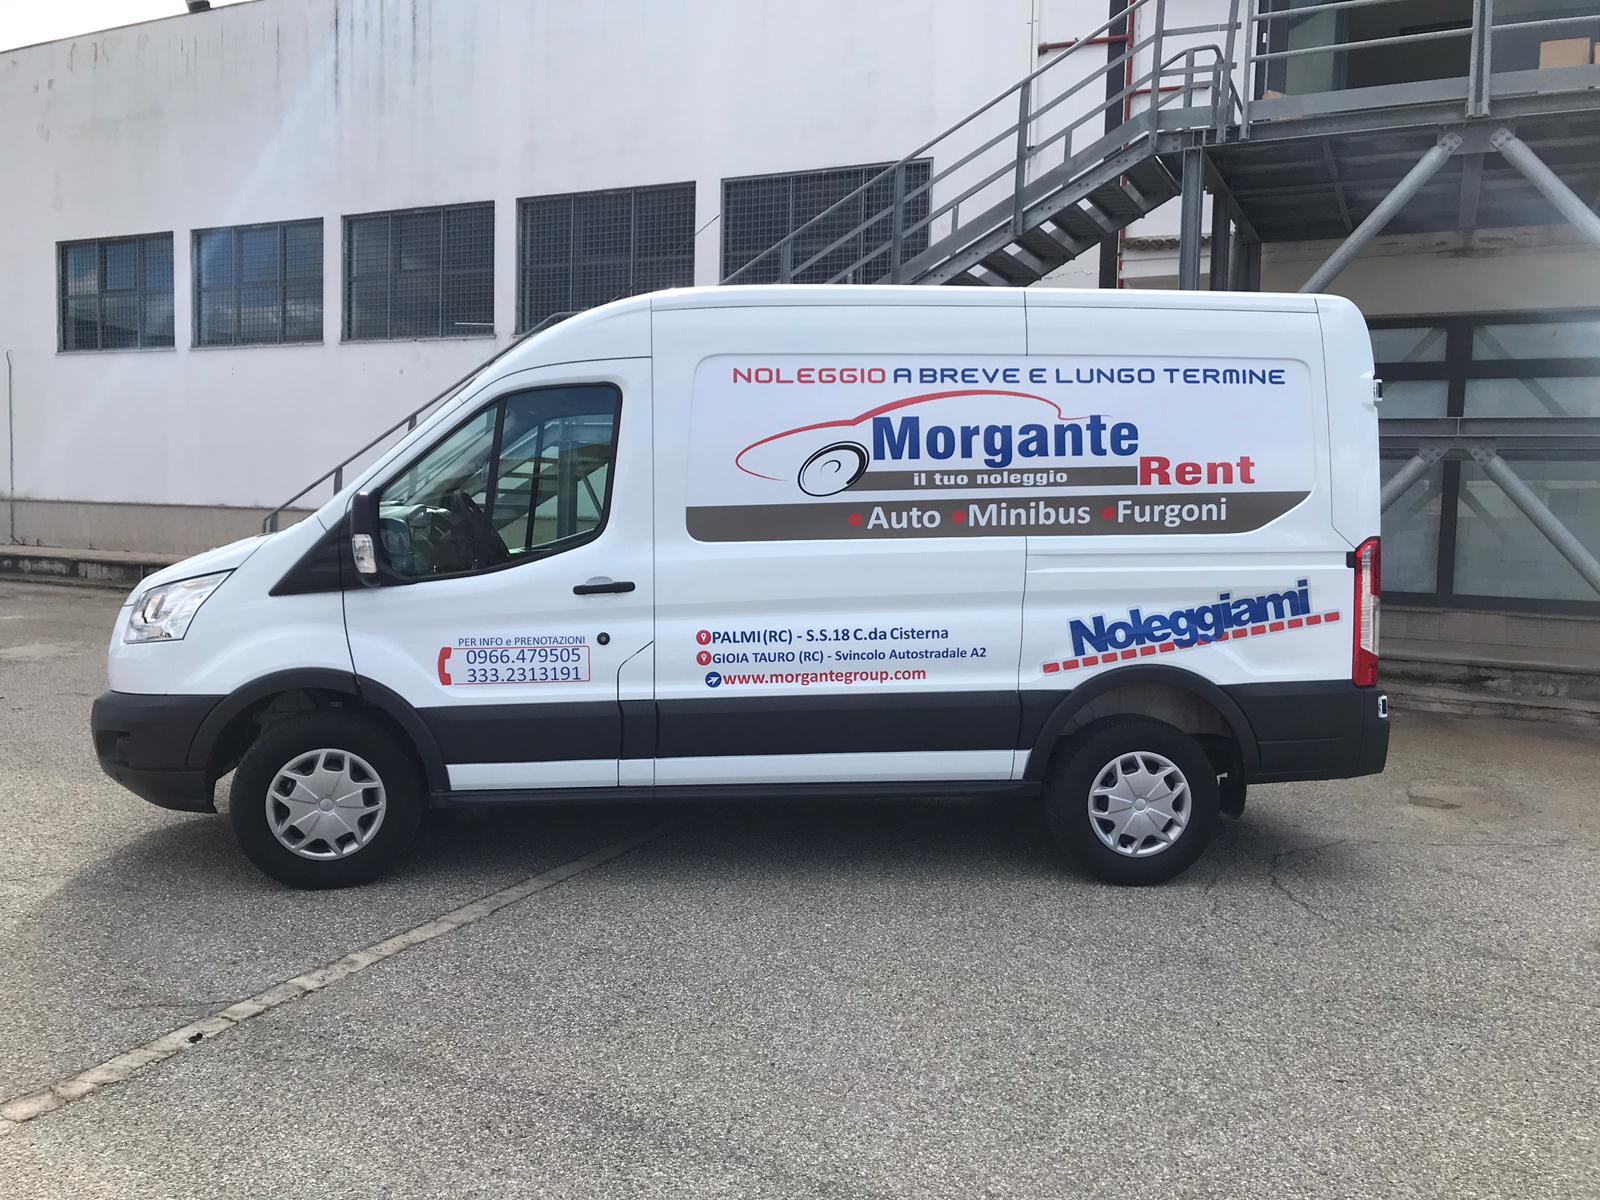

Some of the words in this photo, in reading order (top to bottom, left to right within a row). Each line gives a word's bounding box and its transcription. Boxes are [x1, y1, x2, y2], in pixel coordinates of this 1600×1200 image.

[733, 367, 886, 384] NOLEGGIO
[893, 368, 912, 384] A
[919, 368, 1021, 384] BREVE
[1028, 368, 1047, 385] E
[1055, 368, 1155, 384] LUNGO
[1163, 368, 1286, 385] TERMINE
[872, 415, 1139, 468] Morgante
[912, 474, 926, 486] il
[934, 473, 969, 486] tuo
[976, 470, 1068, 486] noleggio
[1139, 456, 1255, 486] Rent
[867, 506, 941, 530] Auto
[968, 501, 1091, 528] Minibus
[1117, 498, 1227, 527] Furgoni
[1069, 579, 1310, 656] Noleggiami
[458, 638, 477, 647] PER
[479, 637, 503, 646] INFO
[514, 636, 585, 645] PRENOTAZIONI
[806, 629, 850, 642] S.S.18
[853, 627, 887, 641] C.da
[890, 627, 949, 640] Cisterna
[466, 648, 581, 664] 0966.479505
[712, 653, 749, 664] GIOIA
[752, 652, 795, 663] TAURO
[799, 650, 824, 664] (RC)
[835, 649, 886, 661] Svincolo
[889, 647, 967, 660] Autostradale
[970, 647, 987, 658] A2
[467, 666, 581, 682] 333.2313191
[723, 669, 926, 685] www.morgantegroup.com
